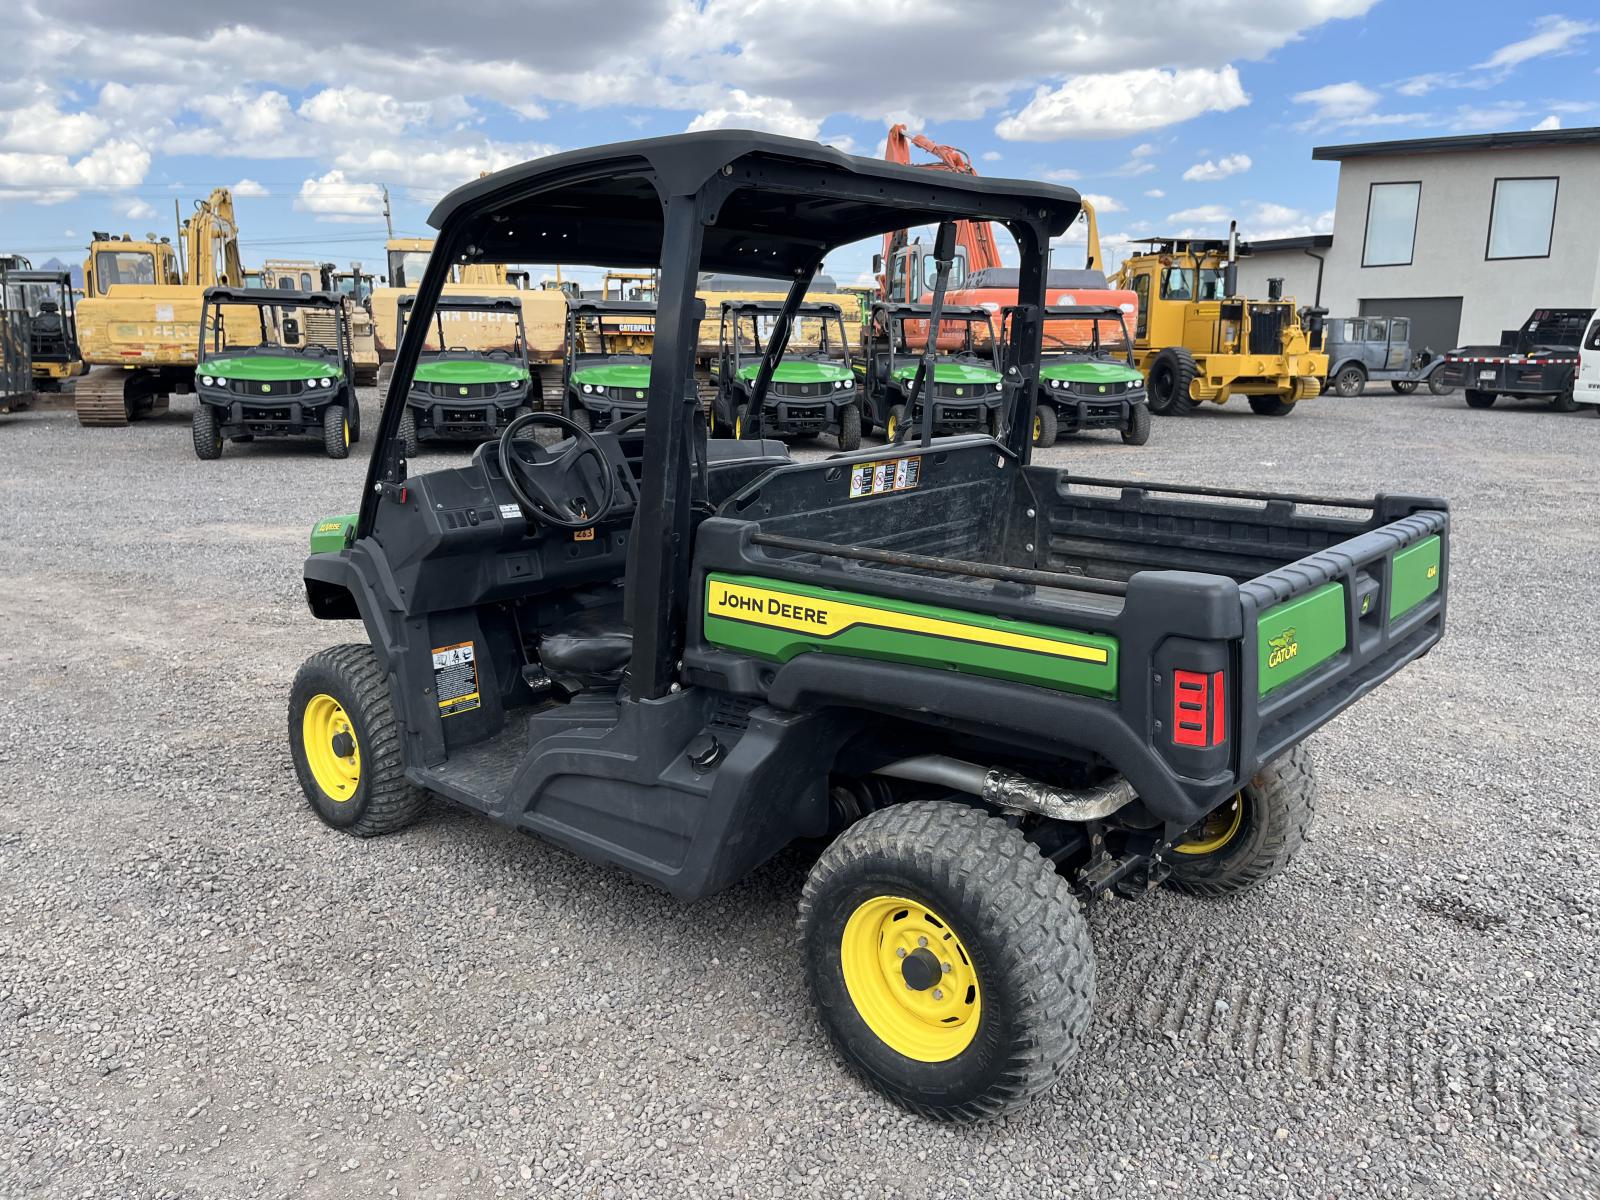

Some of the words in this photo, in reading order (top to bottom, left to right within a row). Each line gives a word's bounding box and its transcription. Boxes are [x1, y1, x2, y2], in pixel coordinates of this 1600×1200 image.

[718, 591, 764, 614] JOHN
[768, 598, 828, 625] DEERE
[1268, 642, 1298, 668] GATOR
